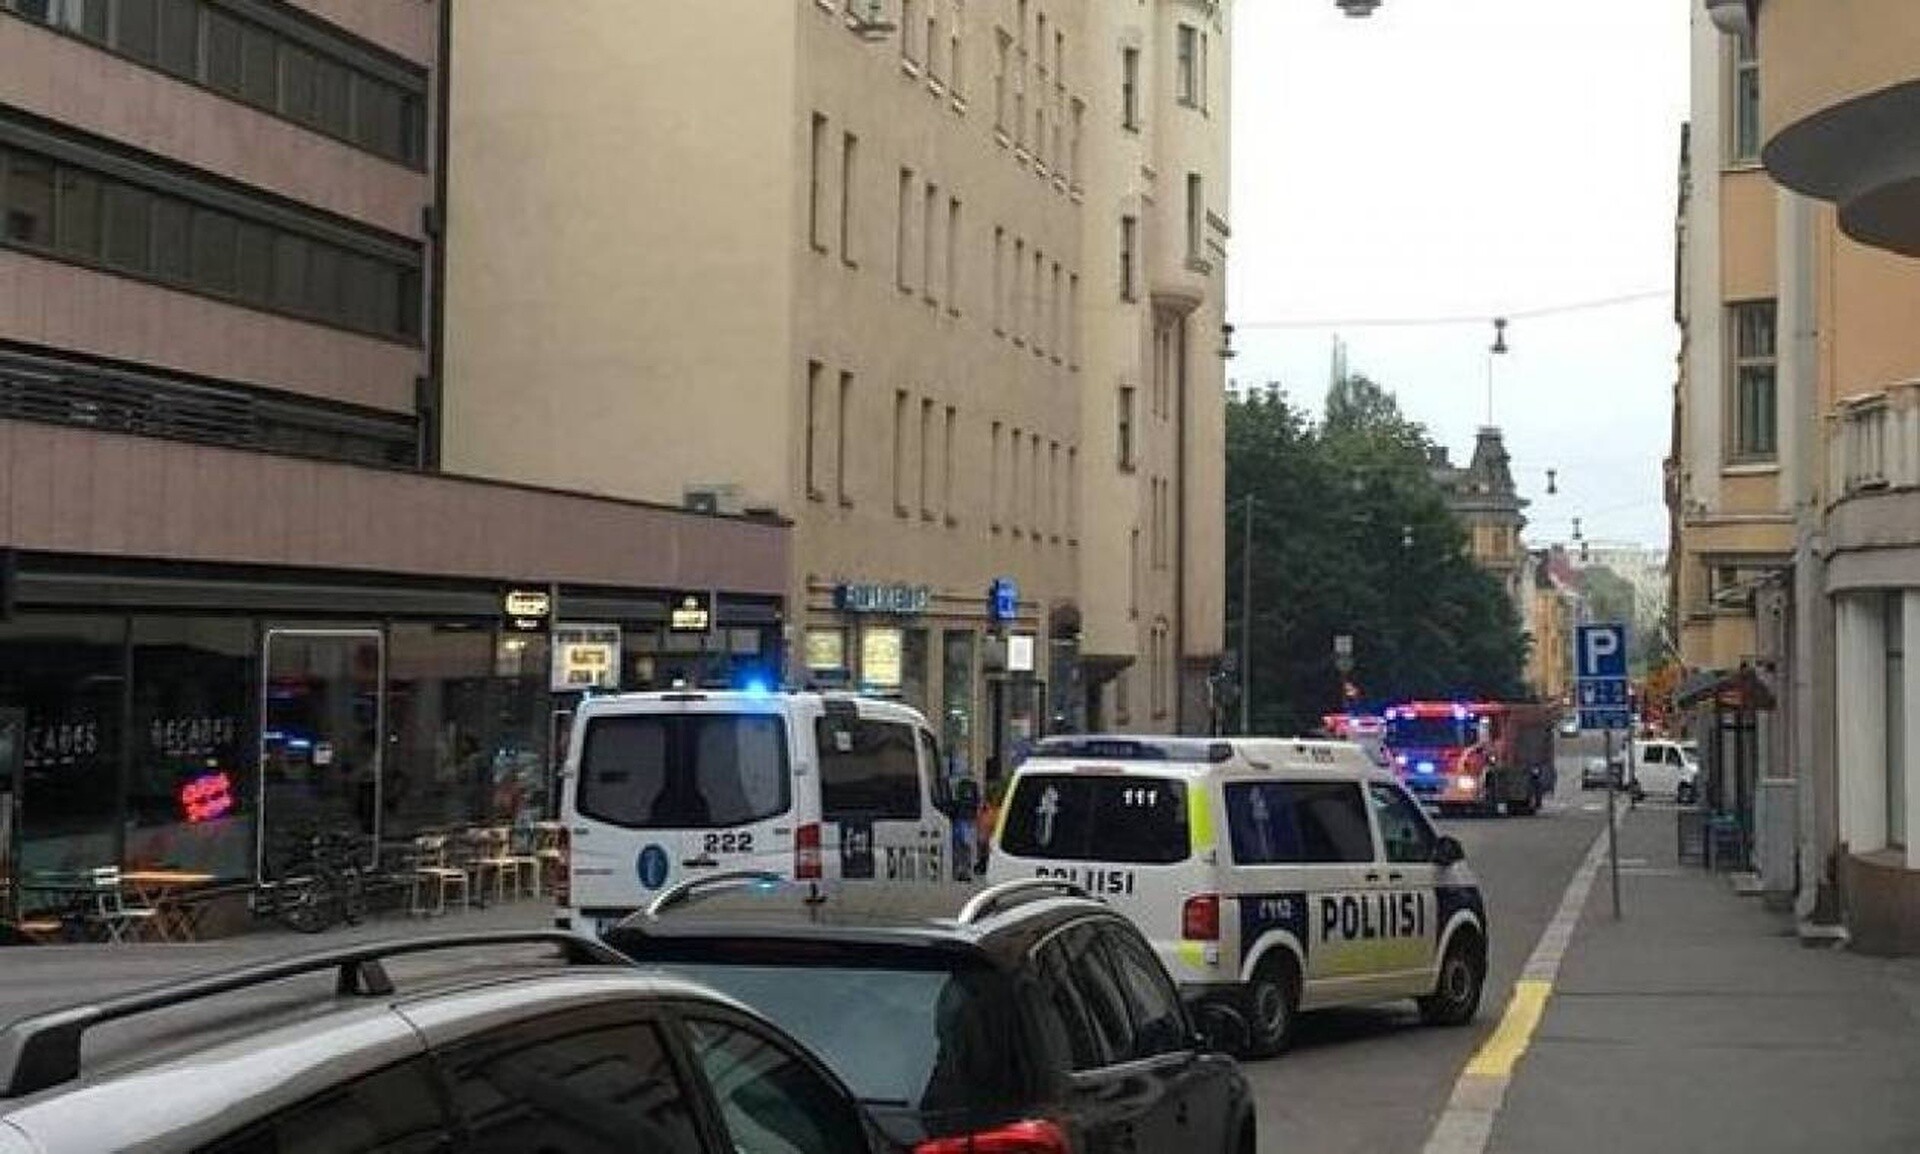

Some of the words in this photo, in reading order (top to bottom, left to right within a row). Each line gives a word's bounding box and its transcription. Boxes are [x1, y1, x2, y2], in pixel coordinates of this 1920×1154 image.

[1586, 629, 1618, 674] P
[703, 833, 753, 854] 222
[1322, 891, 1424, 942] POLIISI
